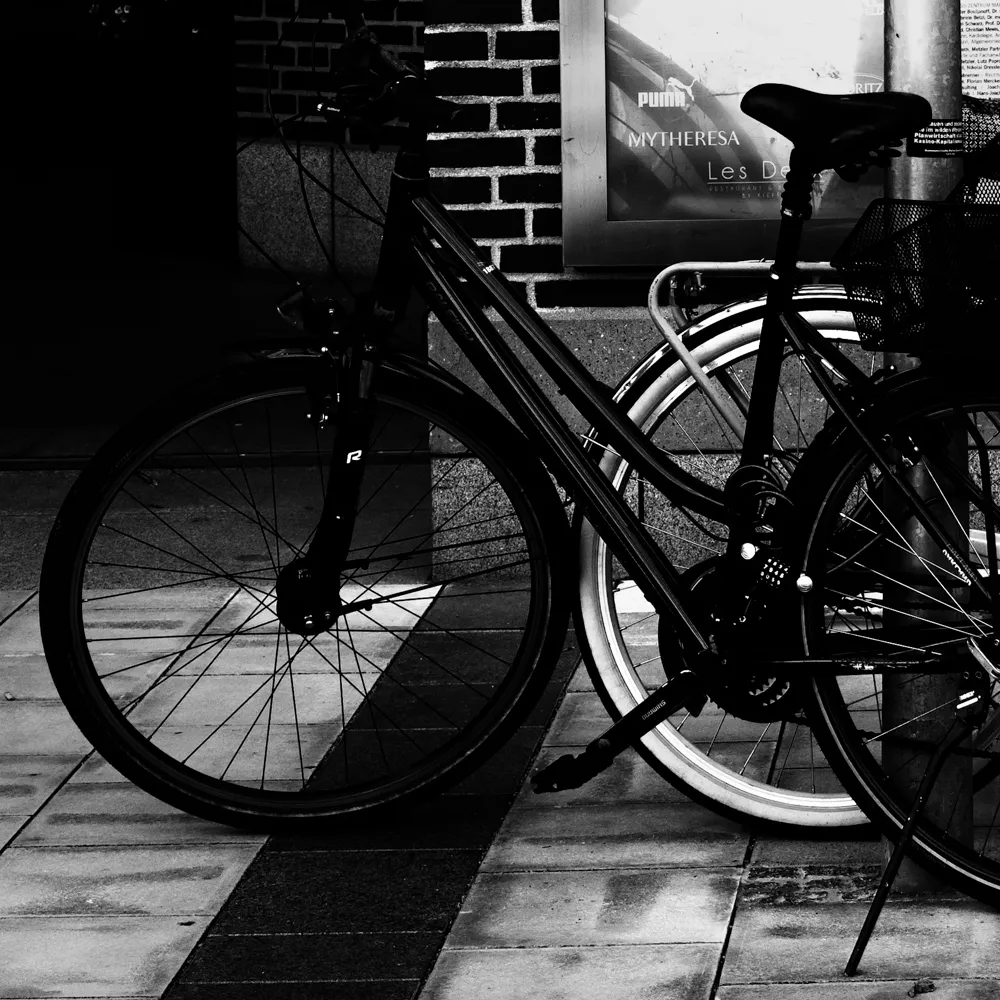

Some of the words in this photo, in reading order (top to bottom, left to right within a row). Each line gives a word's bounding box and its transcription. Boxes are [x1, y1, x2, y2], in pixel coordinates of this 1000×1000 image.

[638, 91, 686, 108] PUMA
[628, 130, 740, 147] MYTHERESA
[707, 161, 748, 180] Les
[709, 184, 762, 192] RESTAURANT
